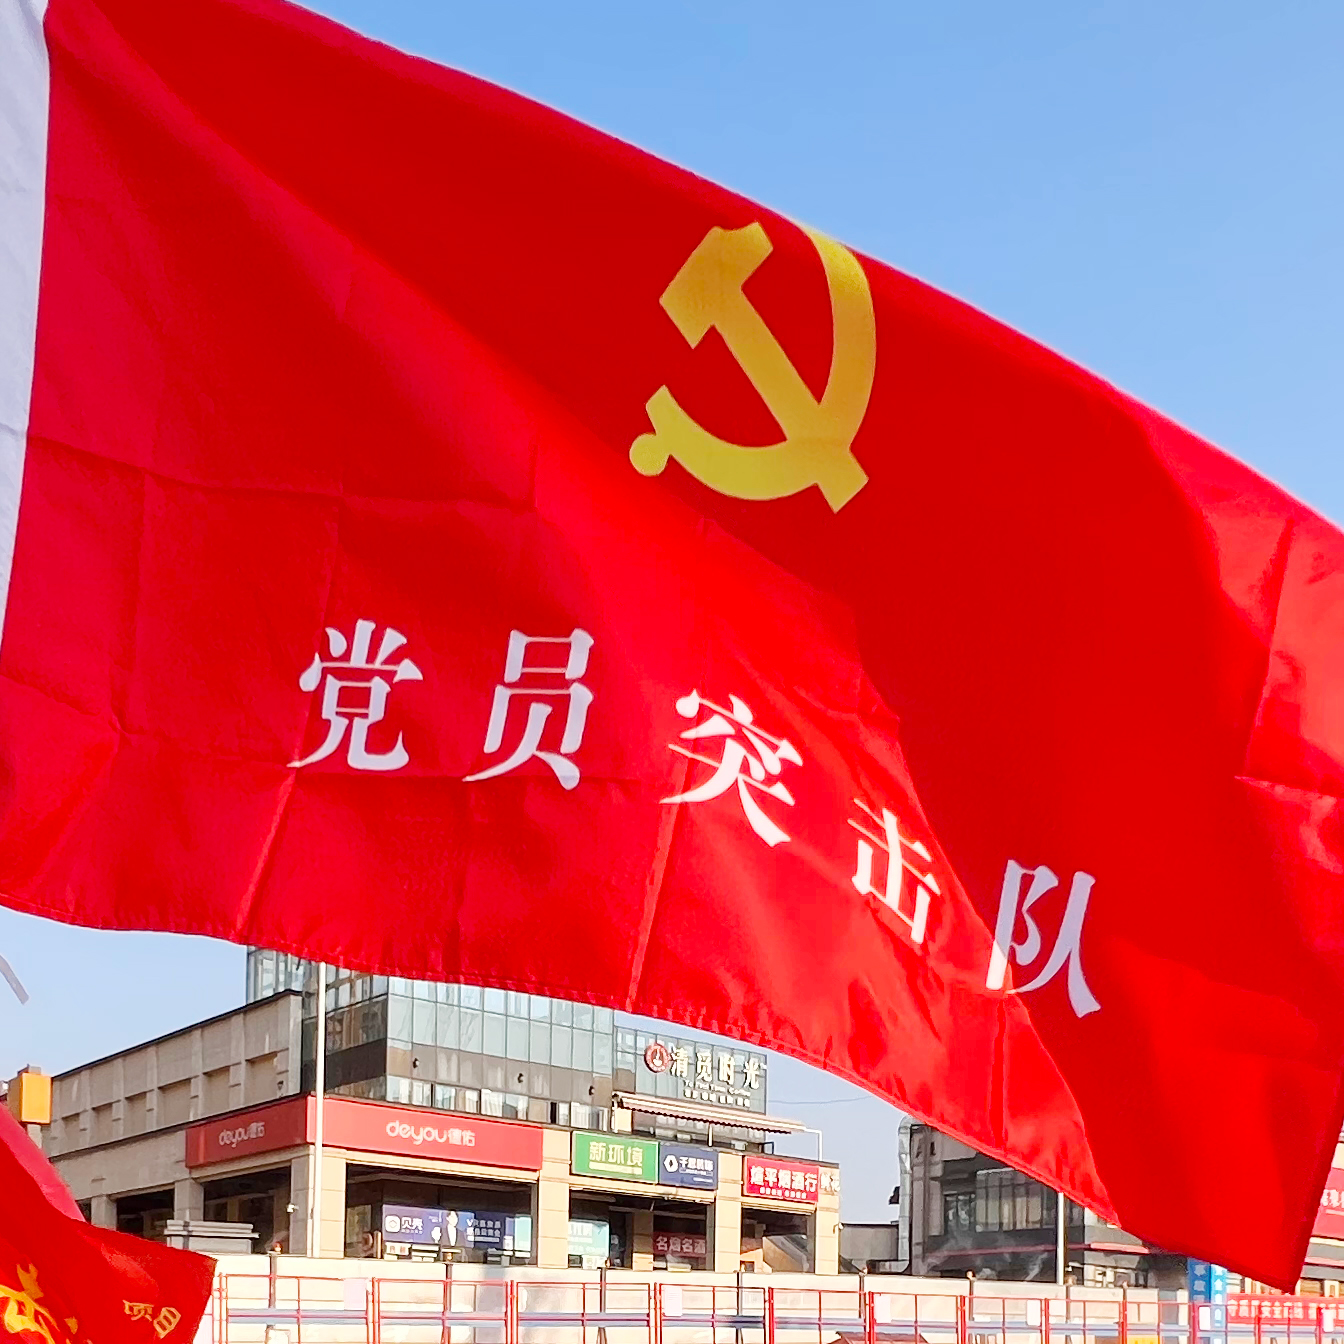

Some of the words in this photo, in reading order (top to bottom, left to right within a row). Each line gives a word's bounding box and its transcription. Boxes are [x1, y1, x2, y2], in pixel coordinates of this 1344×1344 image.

[286, 618, 1102, 1018] 党员突击队
[670, 1047, 760, 1090] 清觅时光
[589, 1141, 643, 1167] 新环境
